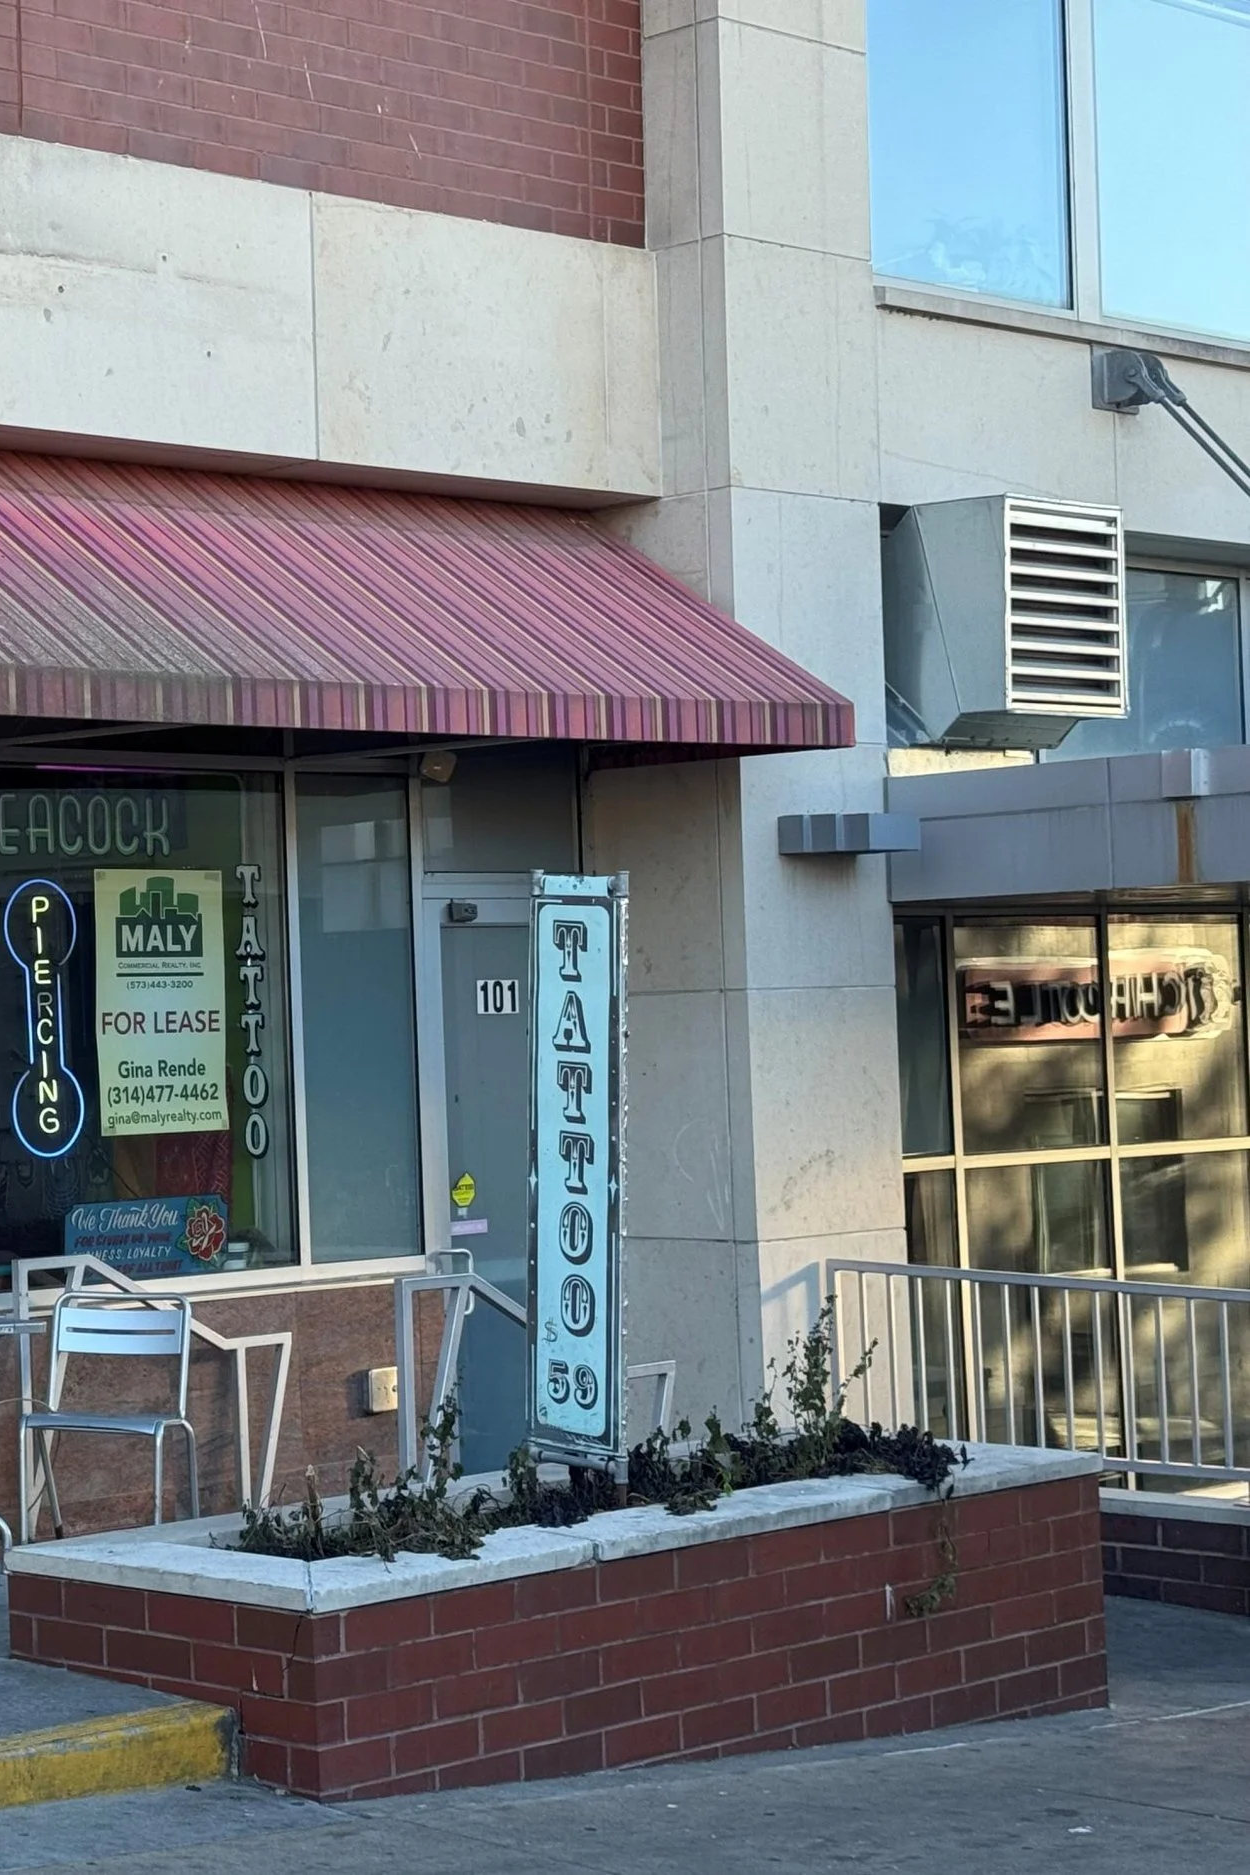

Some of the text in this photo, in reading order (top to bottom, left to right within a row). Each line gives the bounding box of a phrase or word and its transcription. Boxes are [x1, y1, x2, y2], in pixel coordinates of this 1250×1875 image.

[121, 924, 197, 952] MALY
[126, 980, 193, 990] (573)443-3200
[480, 980, 516, 1013] 101
[31, 896, 60, 1134] PIERCING
[101, 1010, 221, 1036] FOR LEASE
[236, 863, 269, 1160] TATTOO
[118, 1057, 206, 1079] Gina Rende
[107, 1082, 219, 1107] (314)477-4462
[108, 1107, 222, 1129] gina@malyrealty.com
[552, 919, 597, 1338] TATTOO
[71, 1203, 178, 1233] We Thank You
[127, 1246, 172, 1259] LOYALTY
[542, 1317, 559, 1344] $
[547, 1358, 598, 1410] 59
